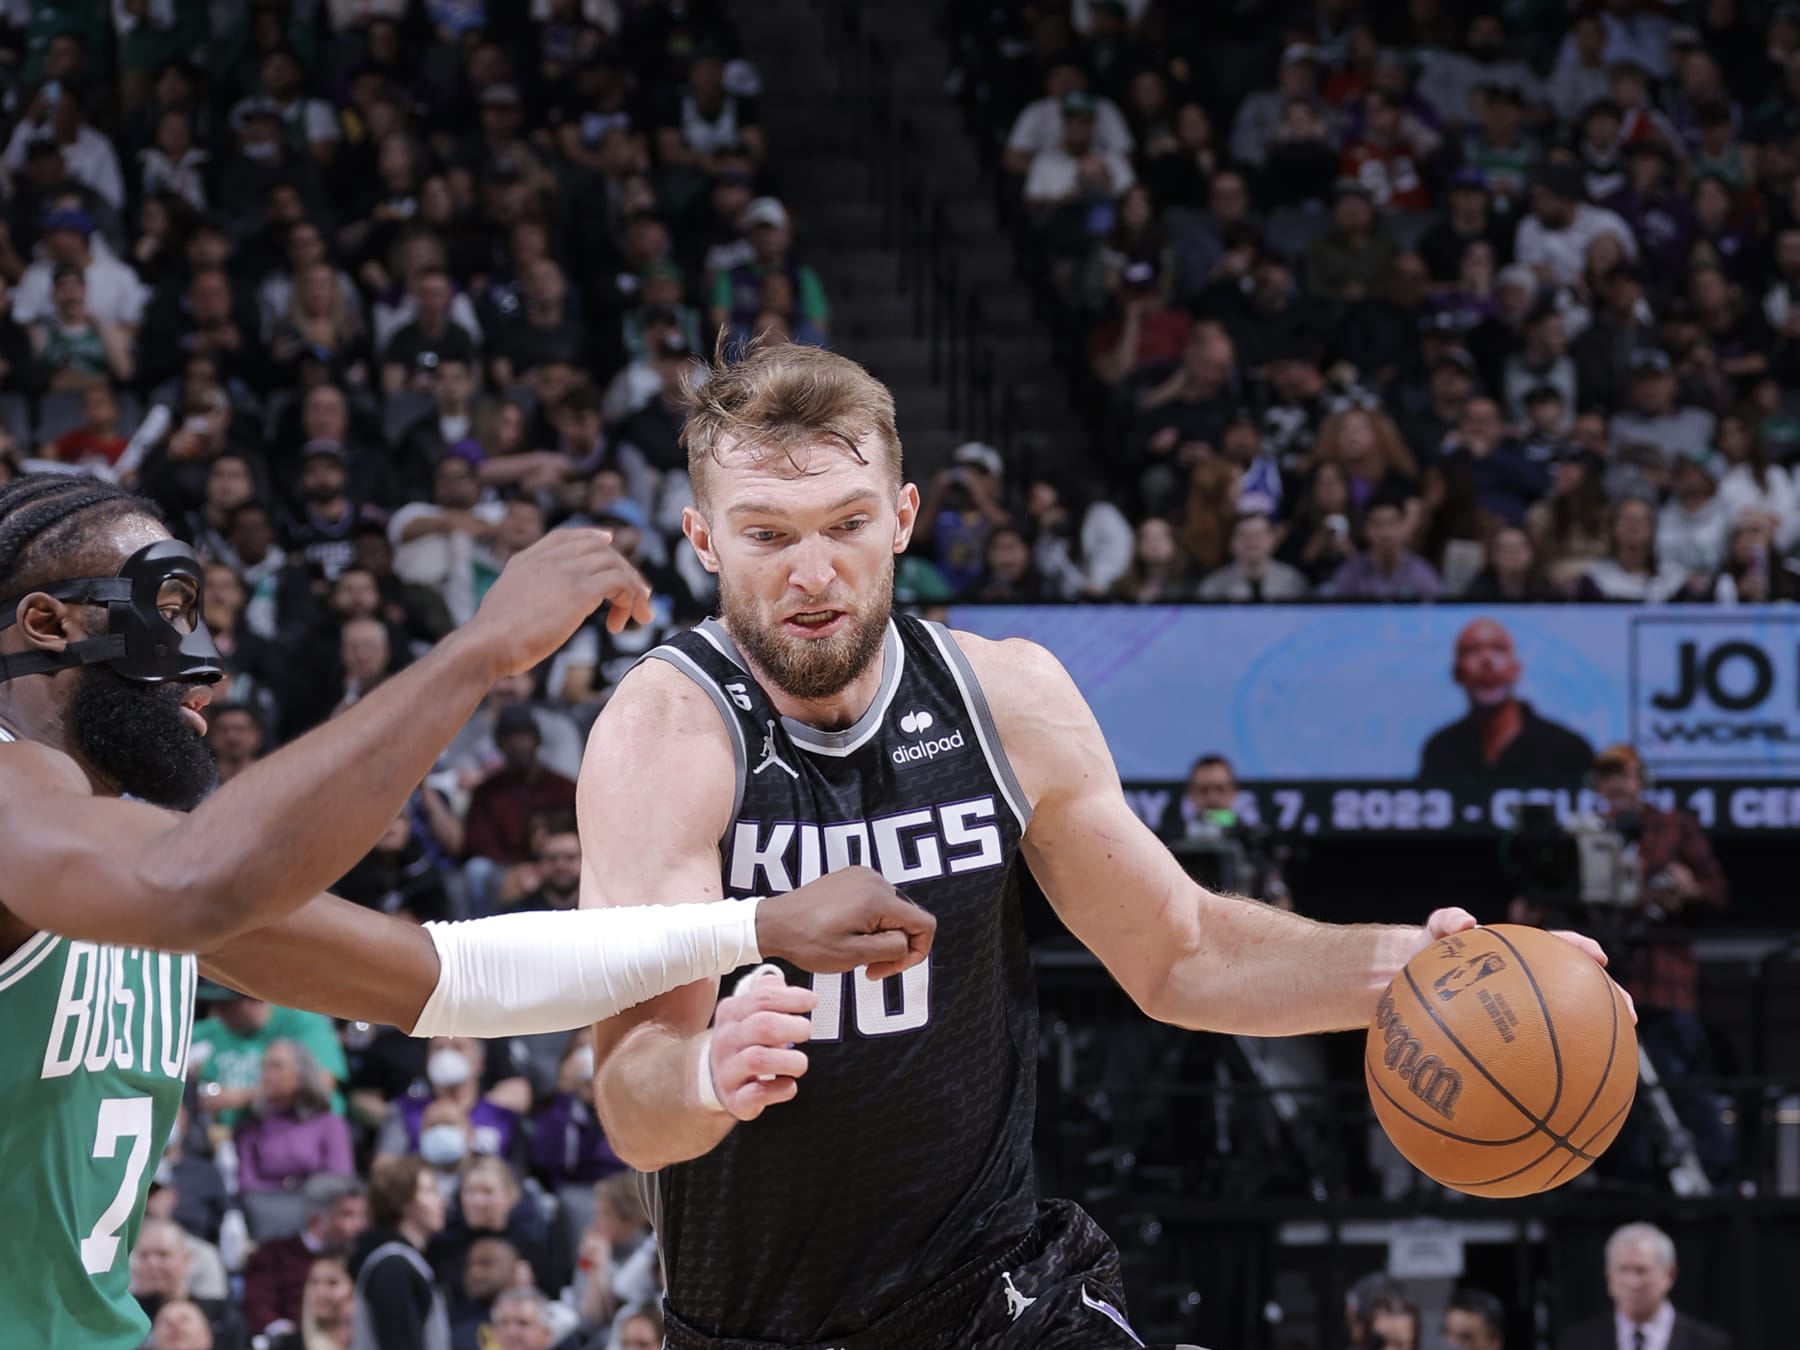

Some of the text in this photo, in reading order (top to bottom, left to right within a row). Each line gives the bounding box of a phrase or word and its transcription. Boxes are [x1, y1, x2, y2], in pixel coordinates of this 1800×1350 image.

[725, 683, 753, 711] 6
[1651, 639, 1773, 713] JO
[893, 729, 964, 763] dialpad
[729, 796, 1002, 891] KINGS
[1271, 790, 1320, 833] 7,
[1331, 788, 1455, 830] 2023
[40, 941, 198, 1083] BOSTO
[80, 1096, 153, 1275] 7
